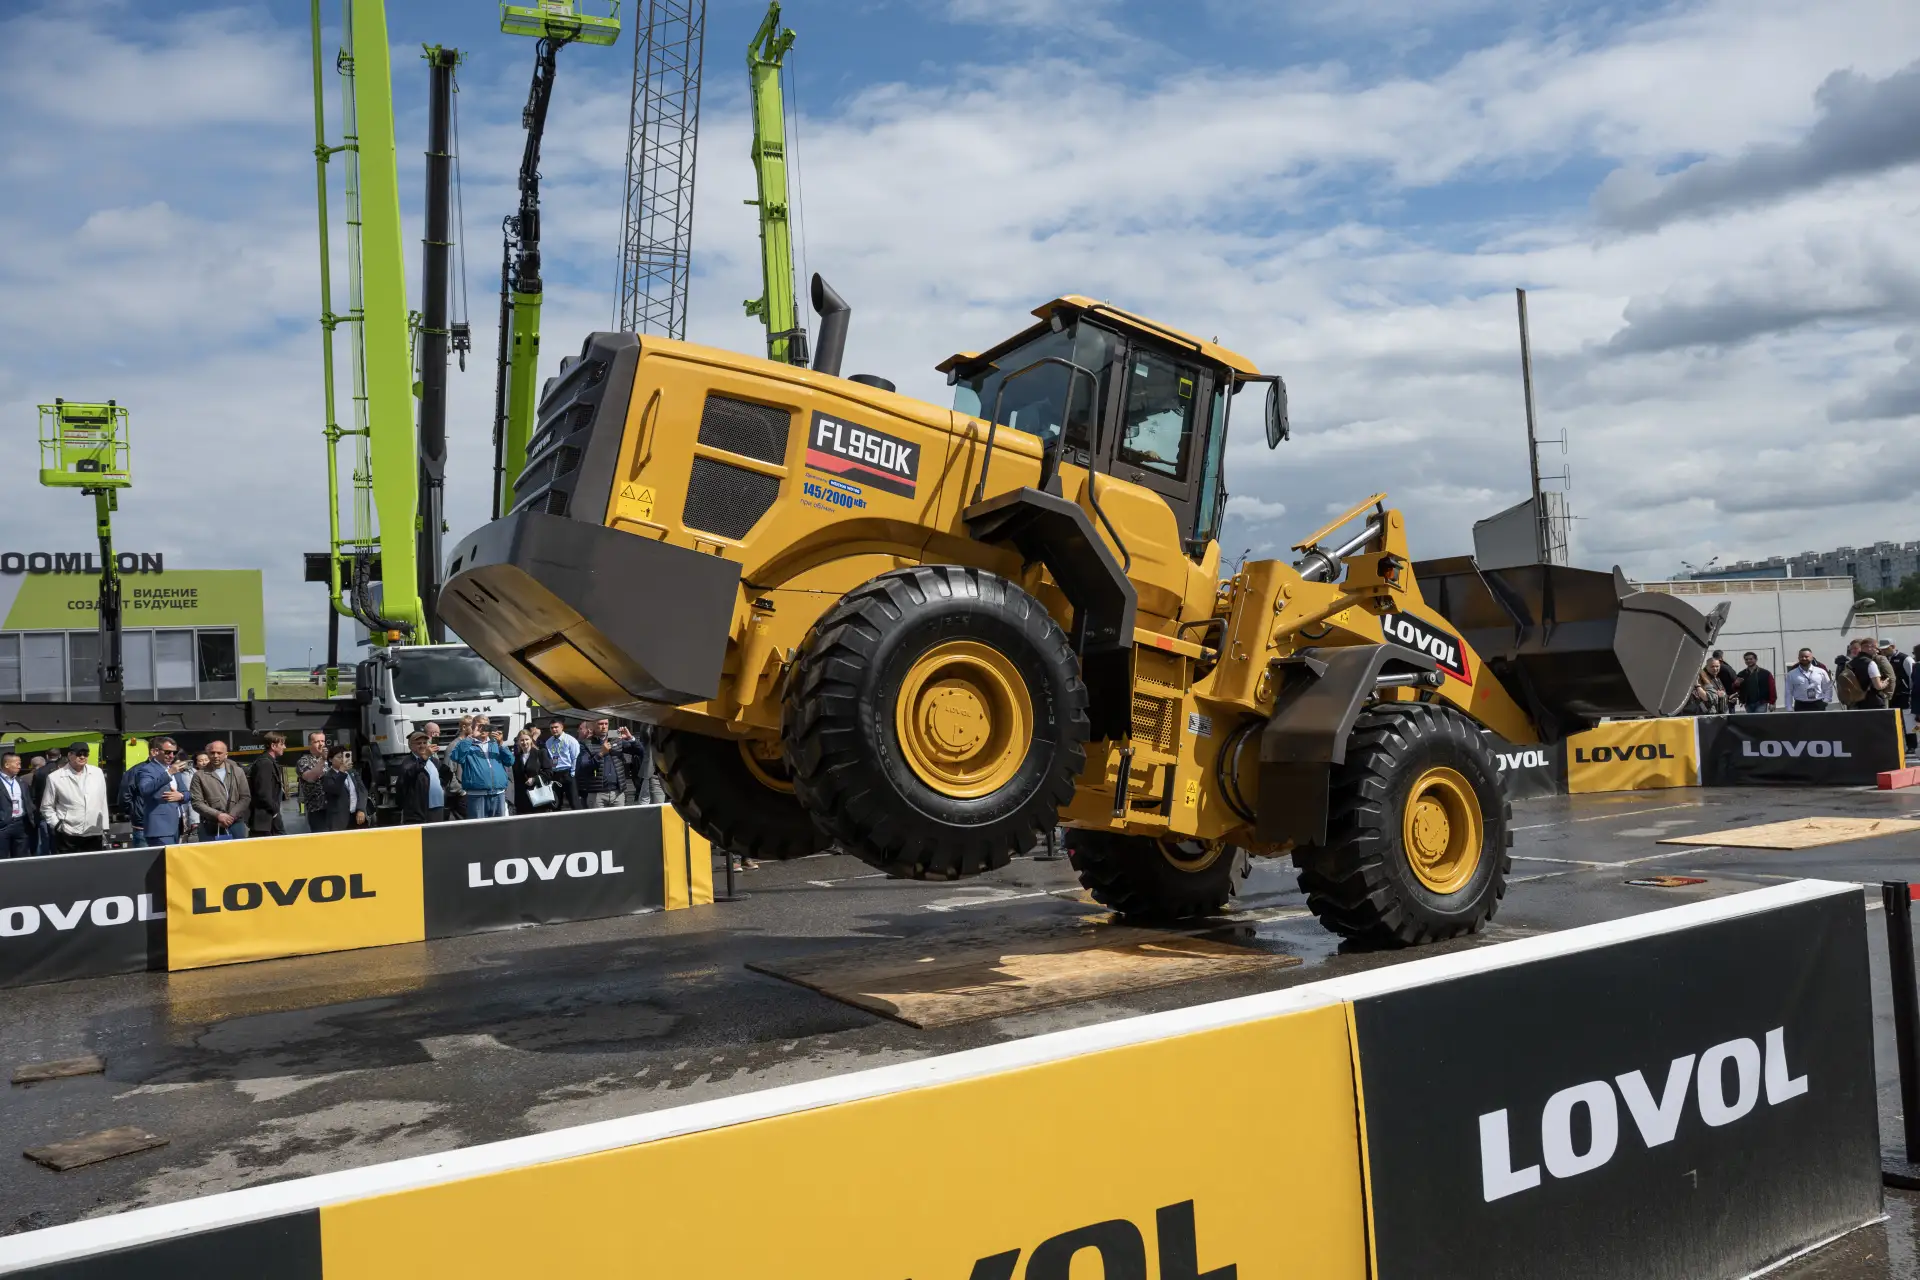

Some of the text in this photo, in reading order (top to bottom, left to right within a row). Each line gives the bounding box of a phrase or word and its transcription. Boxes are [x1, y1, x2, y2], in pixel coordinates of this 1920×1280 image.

[817, 419, 912, 475] FL950K
[1, 552, 163, 574] OOMLON
[133, 588, 198, 598] ВИДЕНИЕ
[67, 599, 198, 610] СОЗДТ БУДУЩЕЕ
[1383, 613, 1459, 668] LOVOL
[431, 705, 492, 716] SITRAK
[1575, 743, 1674, 763] LOVOL
[1742, 740, 1852, 757] LOVOL
[468, 849, 625, 888] LOVOL
[192, 873, 376, 914] LOVOL
[1478, 1025, 1809, 1202] LOVOL
